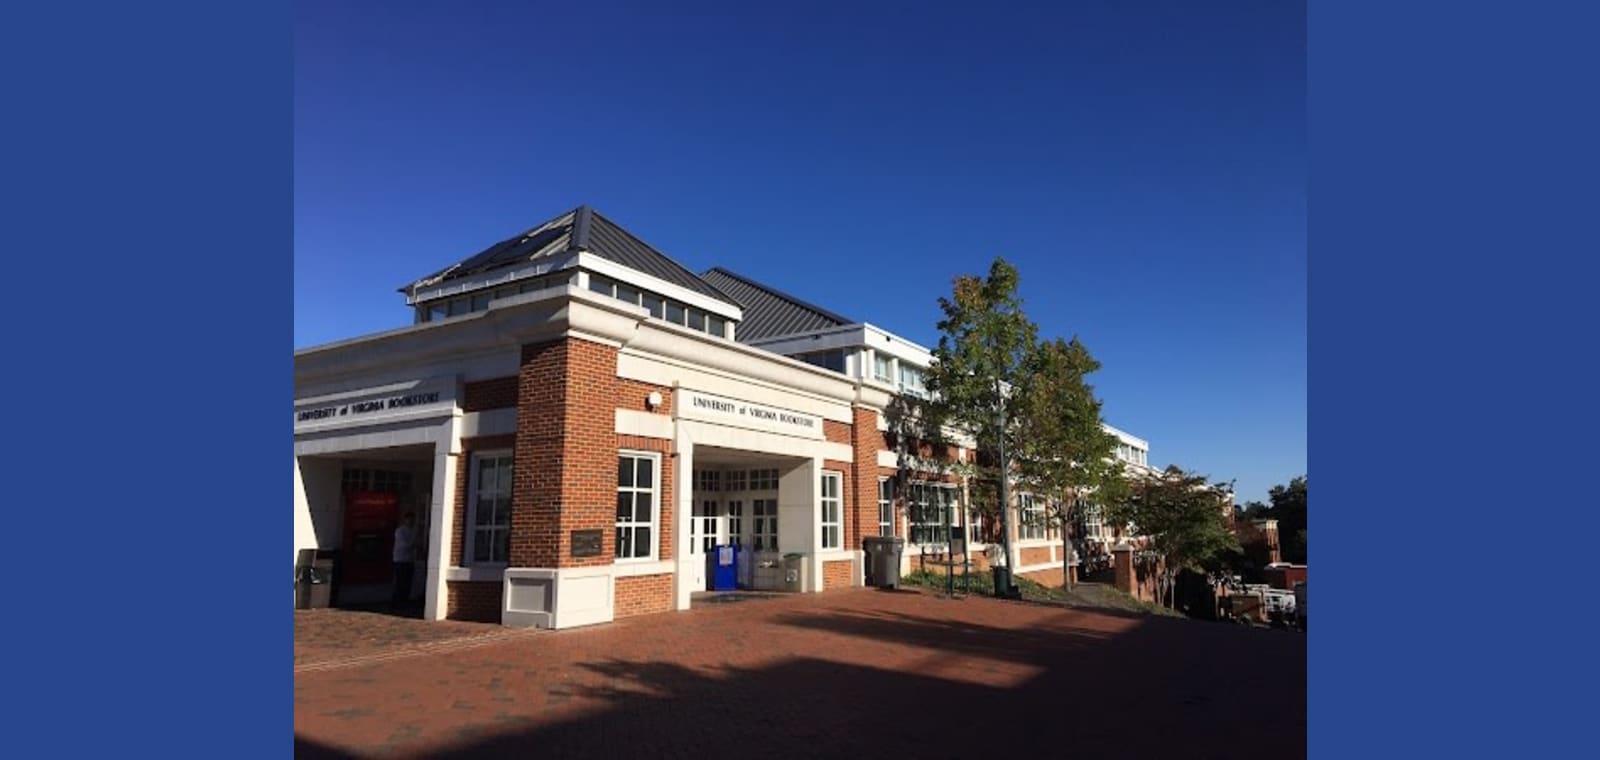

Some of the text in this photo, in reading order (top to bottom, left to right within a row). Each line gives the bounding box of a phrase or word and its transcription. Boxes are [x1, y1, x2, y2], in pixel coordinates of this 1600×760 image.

[298, 392, 441, 421] UNIVERSITY of VIRGINIA BOOKSTORE
[693, 396, 815, 428] UNIVERSITY of VIRGINIA BOOKSTORE
